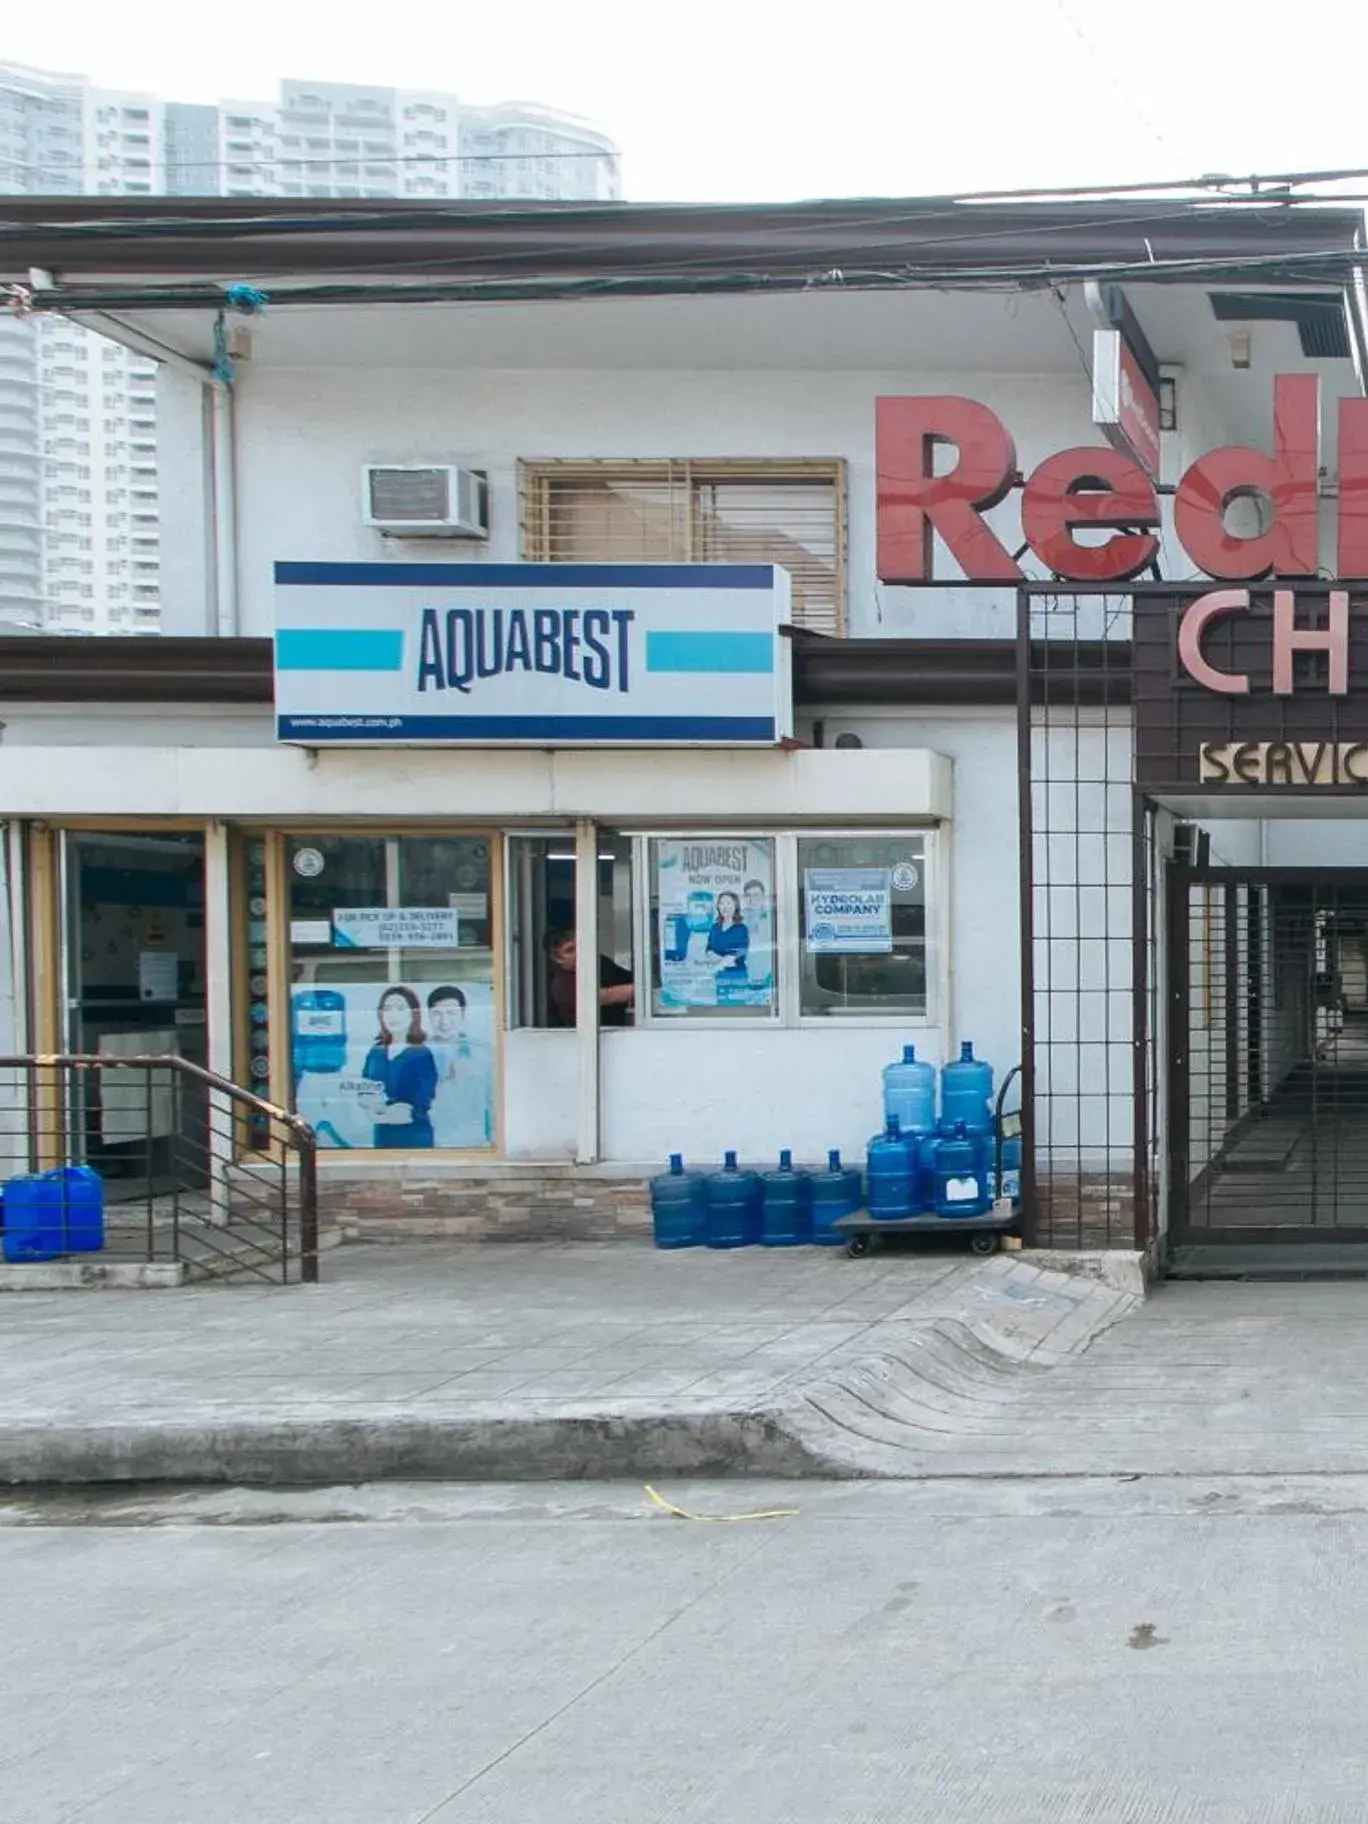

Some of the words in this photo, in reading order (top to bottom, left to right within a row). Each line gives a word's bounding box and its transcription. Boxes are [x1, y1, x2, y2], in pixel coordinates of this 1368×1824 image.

[417, 608, 636, 695] AQUABEST
[682, 846, 748, 872] AQUABEST
[814, 904, 881, 915] COMPANY
